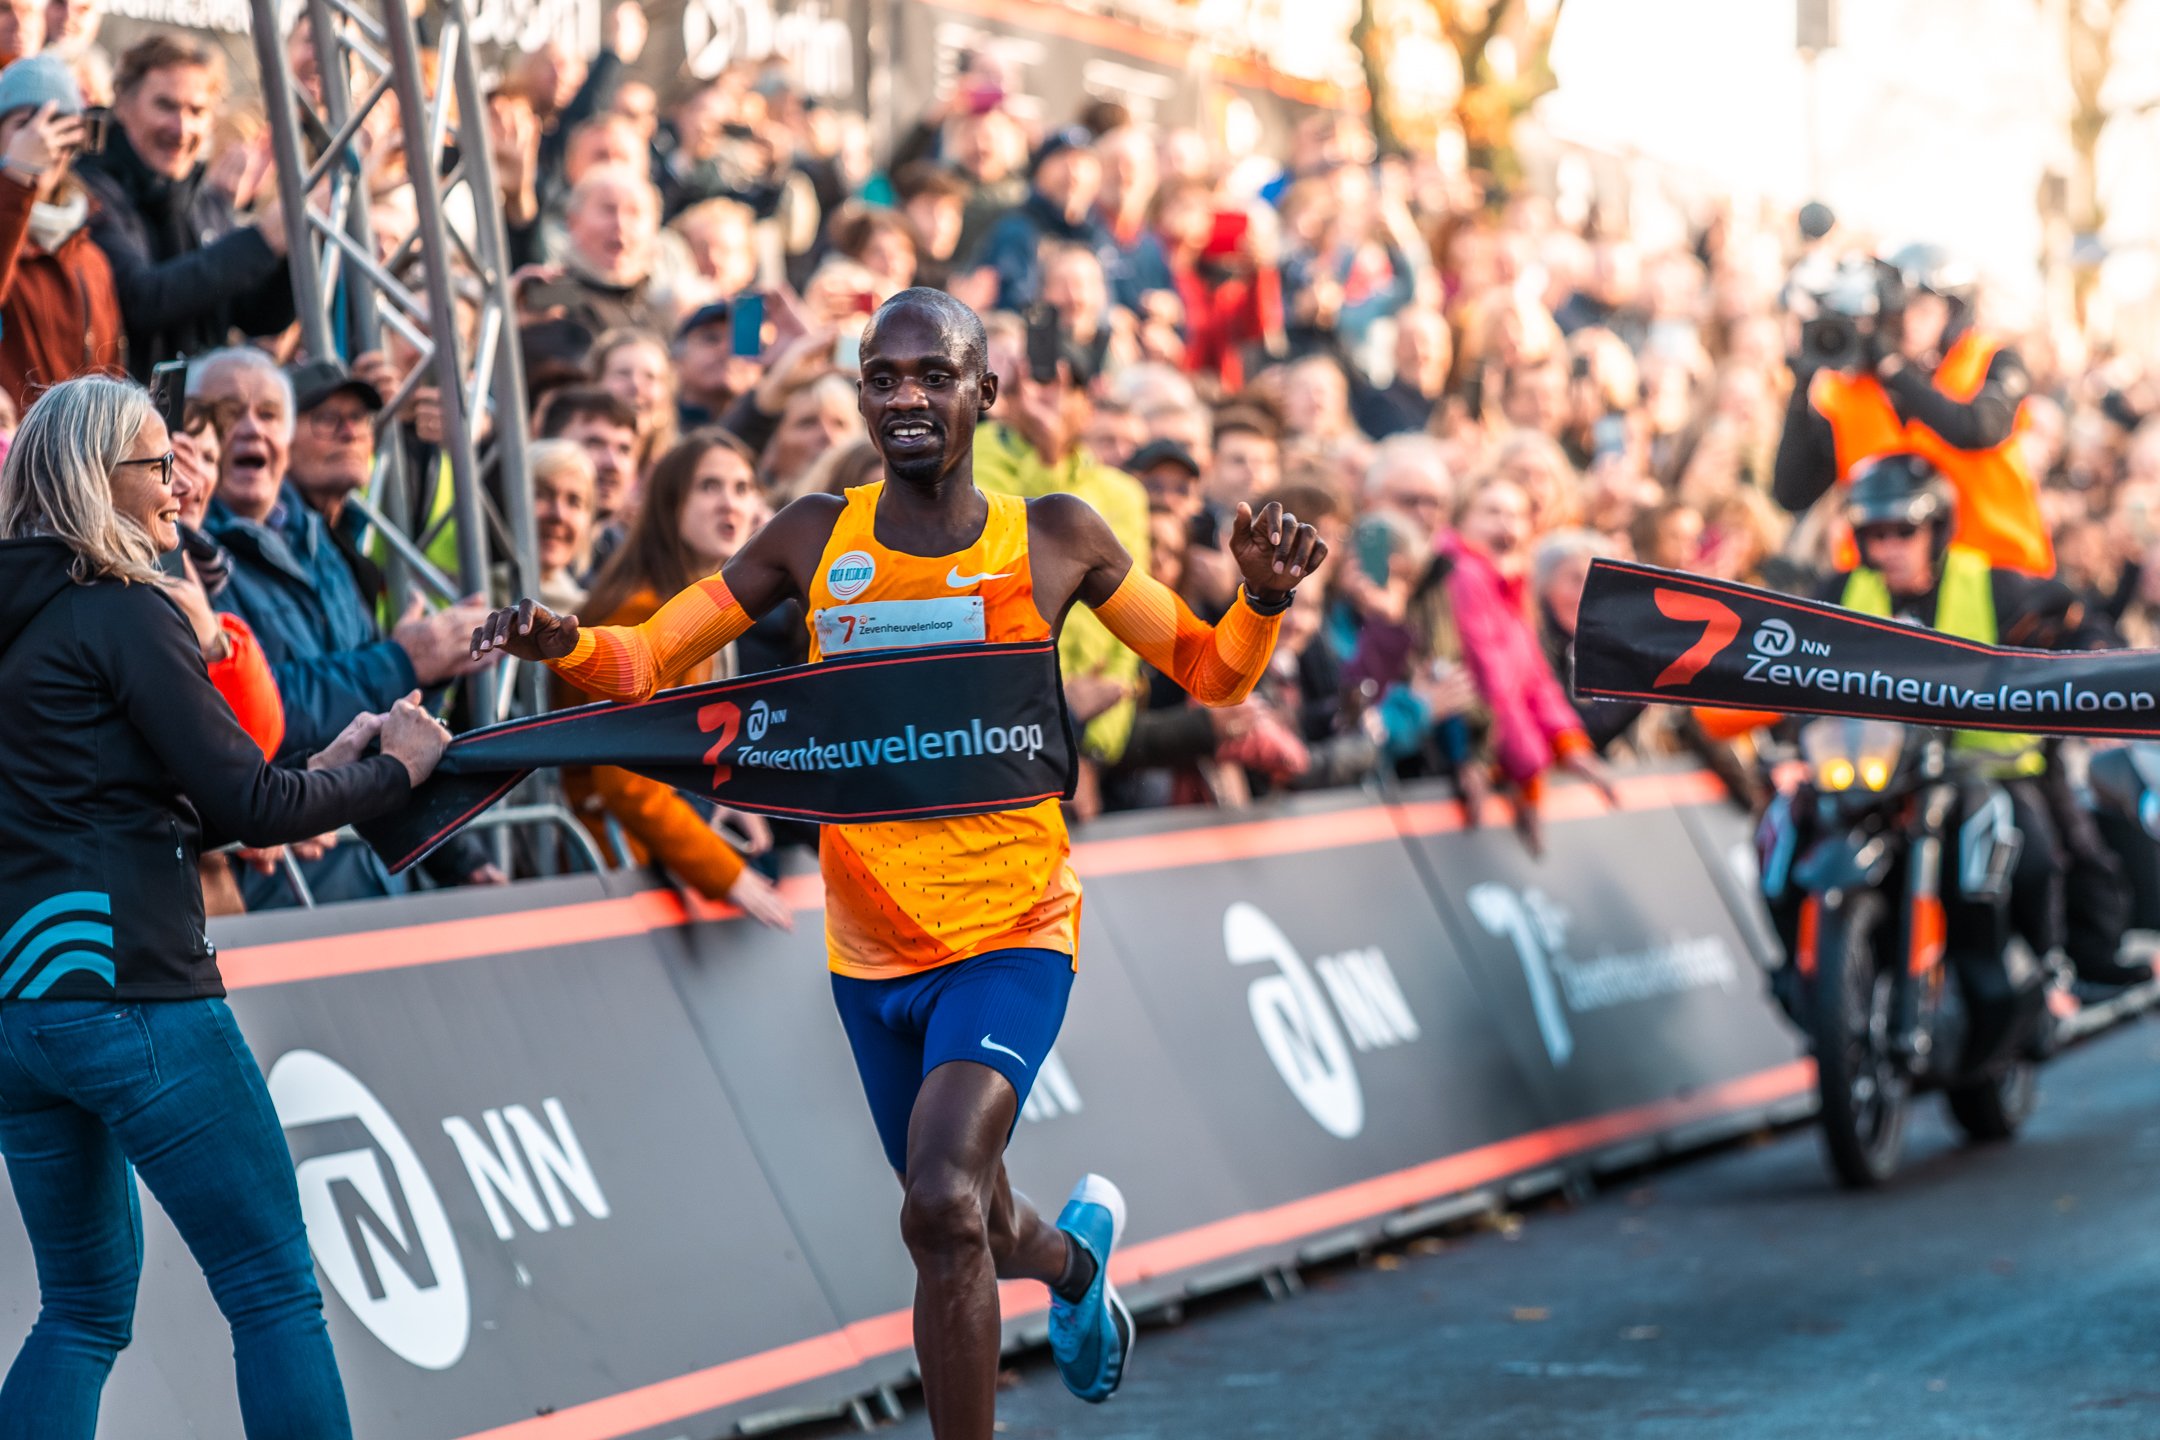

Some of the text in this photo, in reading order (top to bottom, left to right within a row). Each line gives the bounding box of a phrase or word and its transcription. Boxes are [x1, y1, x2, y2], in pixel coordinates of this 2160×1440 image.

[838, 616, 856, 644] 7
[859, 621, 953, 635] Zevenheuvelenloop
[1653, 588, 1741, 688] 7
[1801, 639, 1831, 657] NN
[1743, 653, 2155, 712] Zevenheuvelenloop
[770, 709, 787, 724] NN
[697, 701, 741, 790] 7
[441, 1096, 611, 1240] NN
